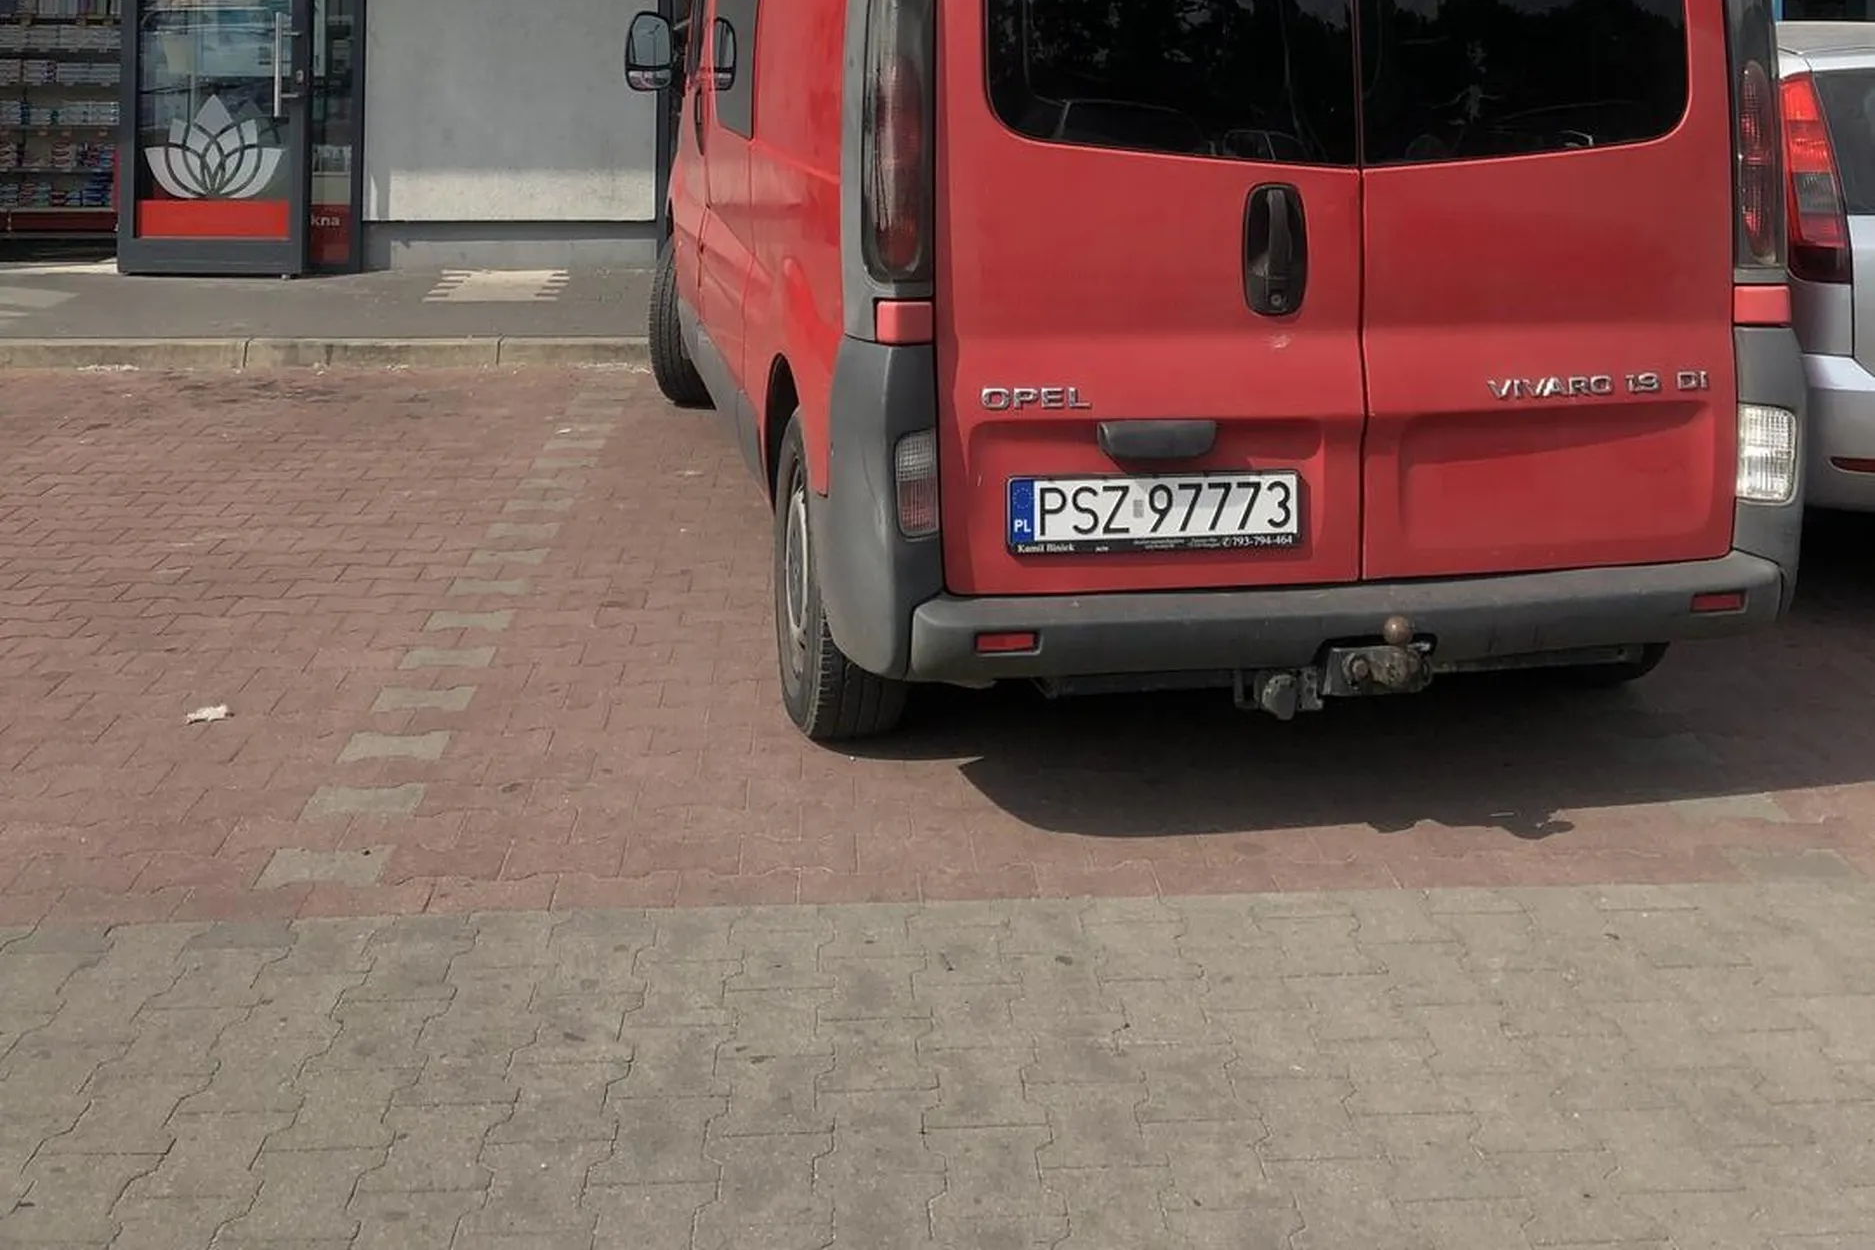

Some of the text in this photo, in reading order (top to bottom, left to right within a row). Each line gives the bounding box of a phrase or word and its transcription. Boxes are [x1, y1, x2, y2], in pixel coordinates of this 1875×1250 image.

[981, 386, 1092, 410] OPEL
[1487, 374, 1612, 398] VIVARO
[1038, 480, 1292, 537] PSZ 97773
[1013, 518, 1032, 533] PL
